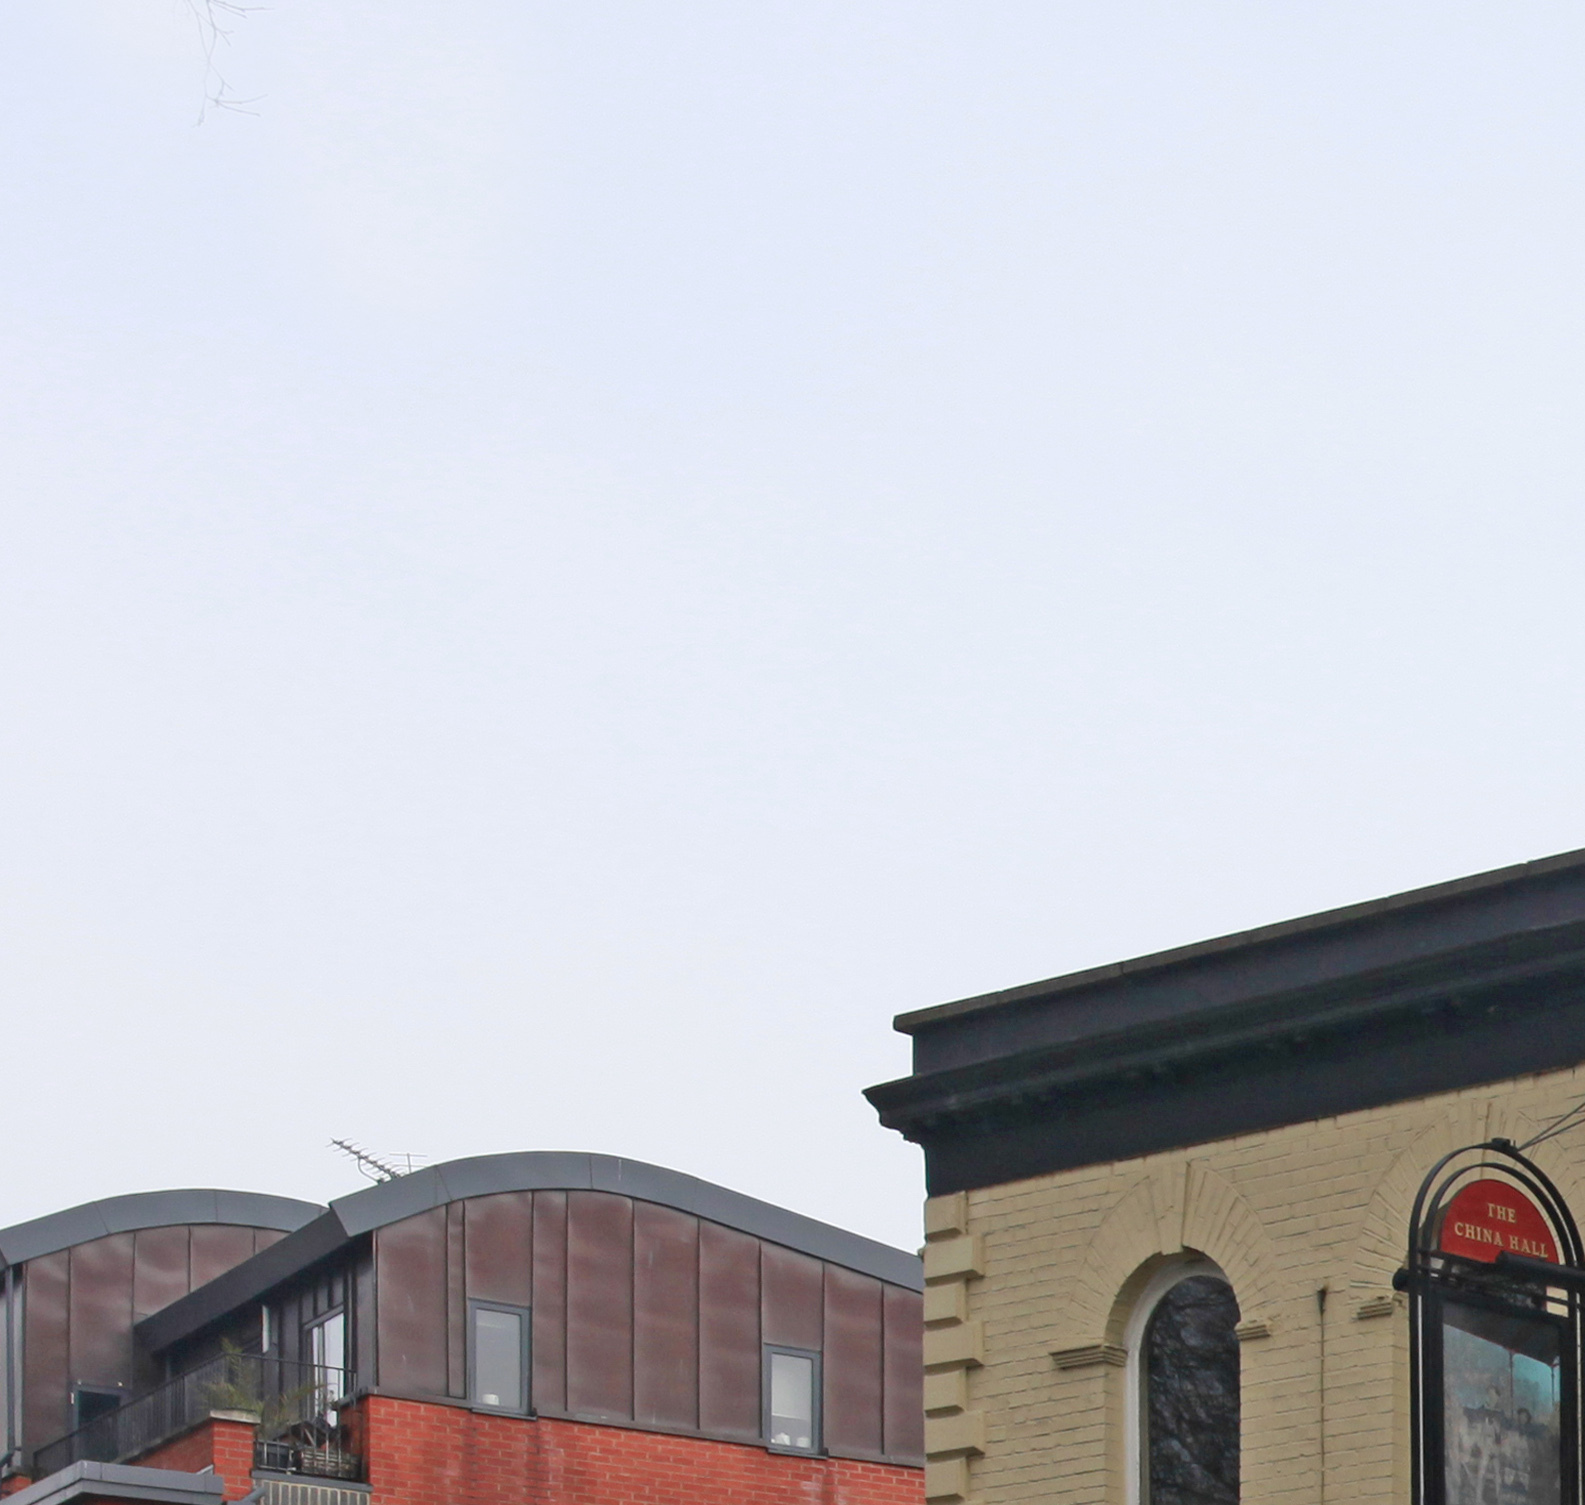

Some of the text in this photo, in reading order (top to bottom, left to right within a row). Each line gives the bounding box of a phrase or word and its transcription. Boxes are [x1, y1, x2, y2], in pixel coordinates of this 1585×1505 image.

[1487, 1203, 1517, 1223] THE
[1454, 1222, 1548, 1258] CHINA HALL
